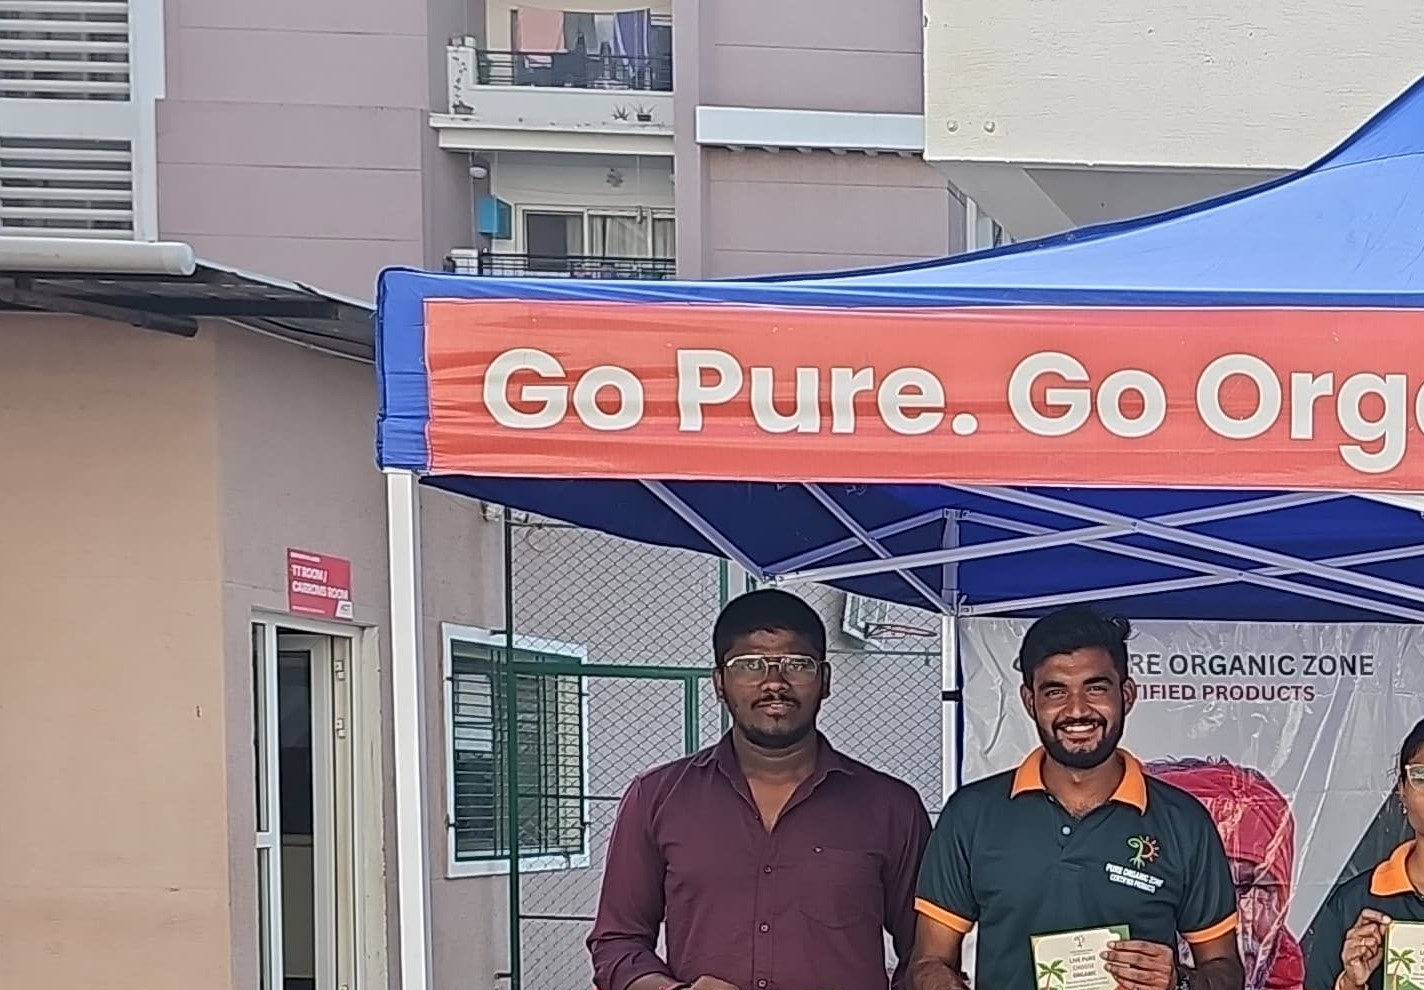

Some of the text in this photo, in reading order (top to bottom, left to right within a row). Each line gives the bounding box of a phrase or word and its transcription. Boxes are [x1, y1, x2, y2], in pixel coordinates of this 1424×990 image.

[482, 347, 644, 432] Go
[676, 349, 980, 437] Pure.
[1007, 351, 1168, 438] Go
[1169, 653, 1297, 677] ORGANIC
[1302, 653, 1375, 677] ZONE
[1202, 685, 1315, 702] PRODUCTS
